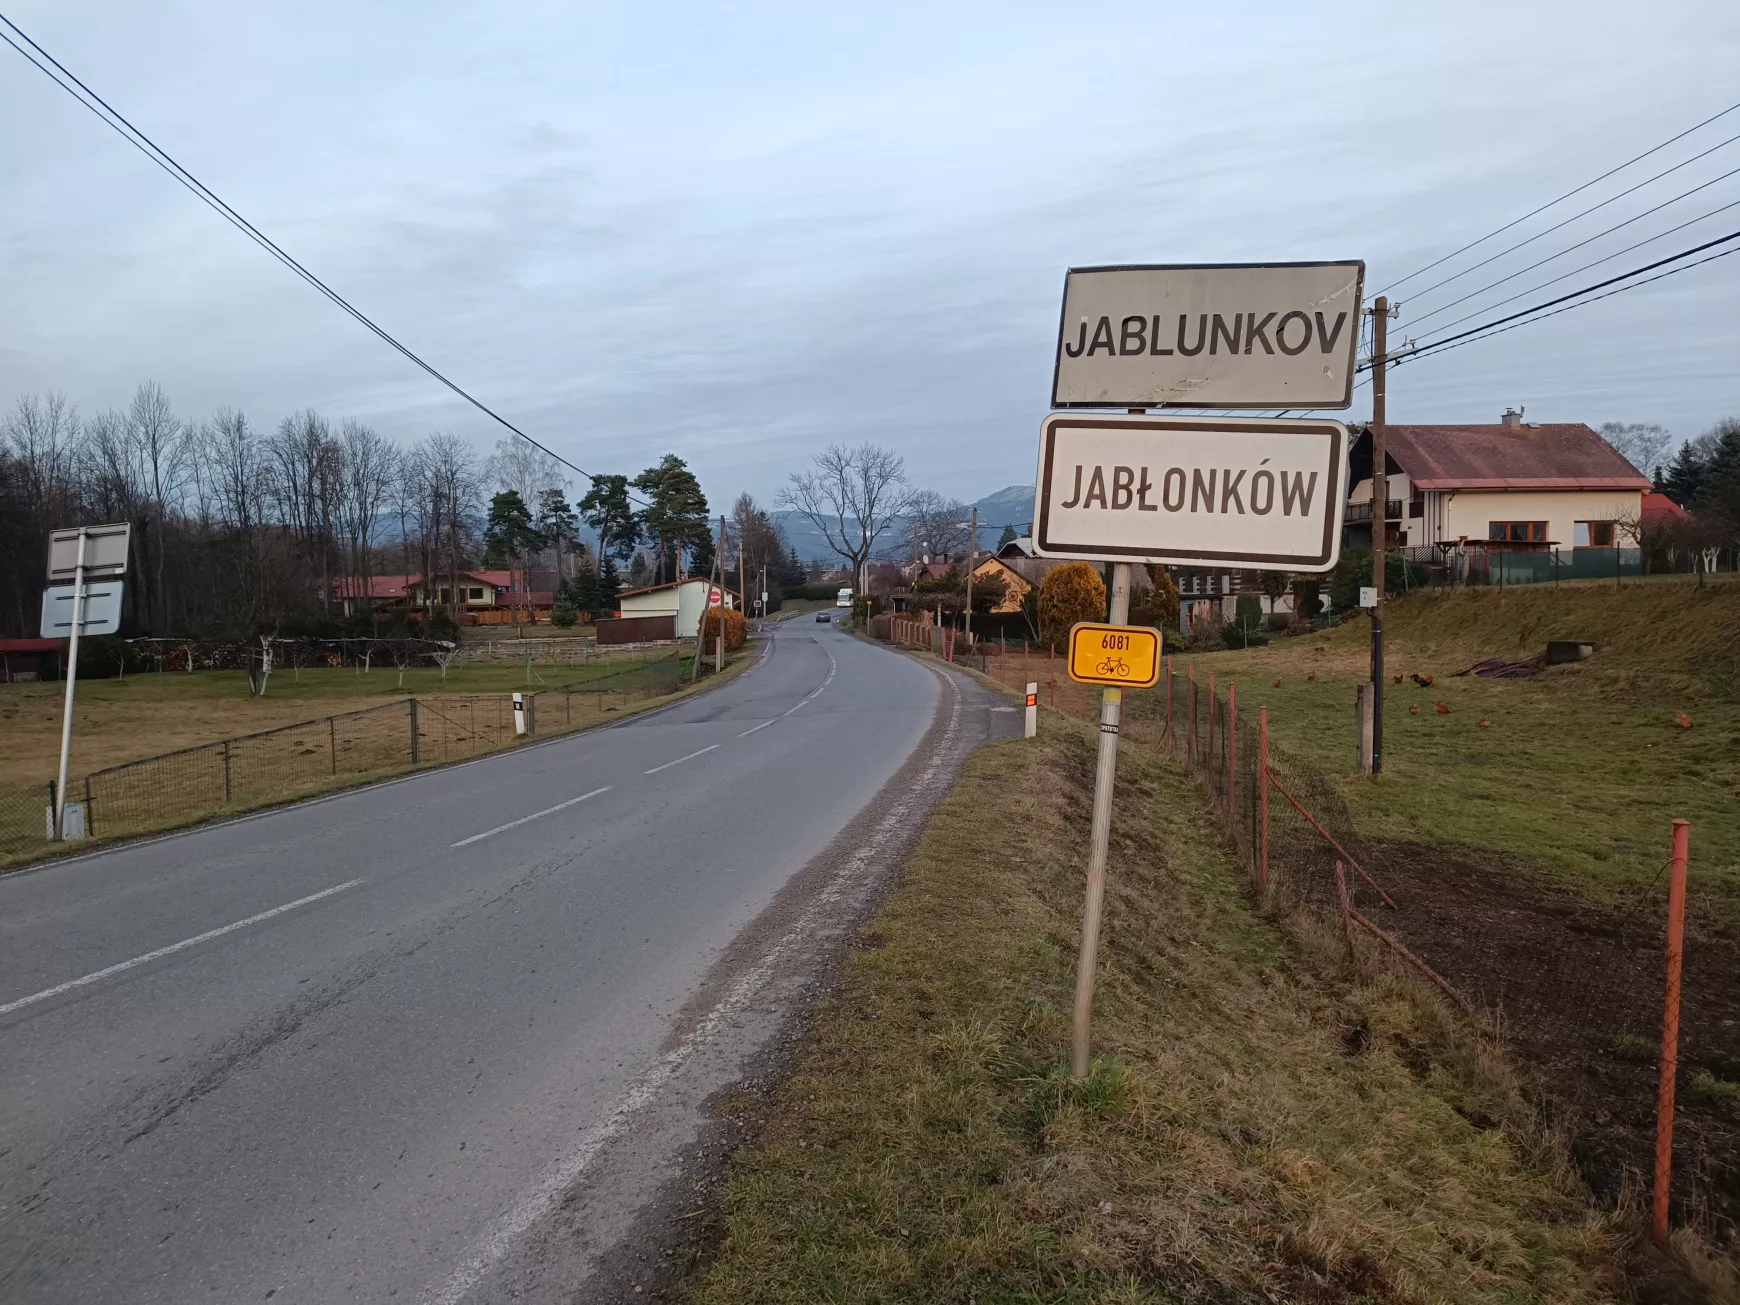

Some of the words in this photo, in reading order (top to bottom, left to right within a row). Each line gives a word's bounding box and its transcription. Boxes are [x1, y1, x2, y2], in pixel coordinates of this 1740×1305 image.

[1065, 310, 1347, 358] JABLUNKOV
[1061, 458, 1318, 517] JABŁONKÓW
[1101, 634, 1130, 651] 6081
